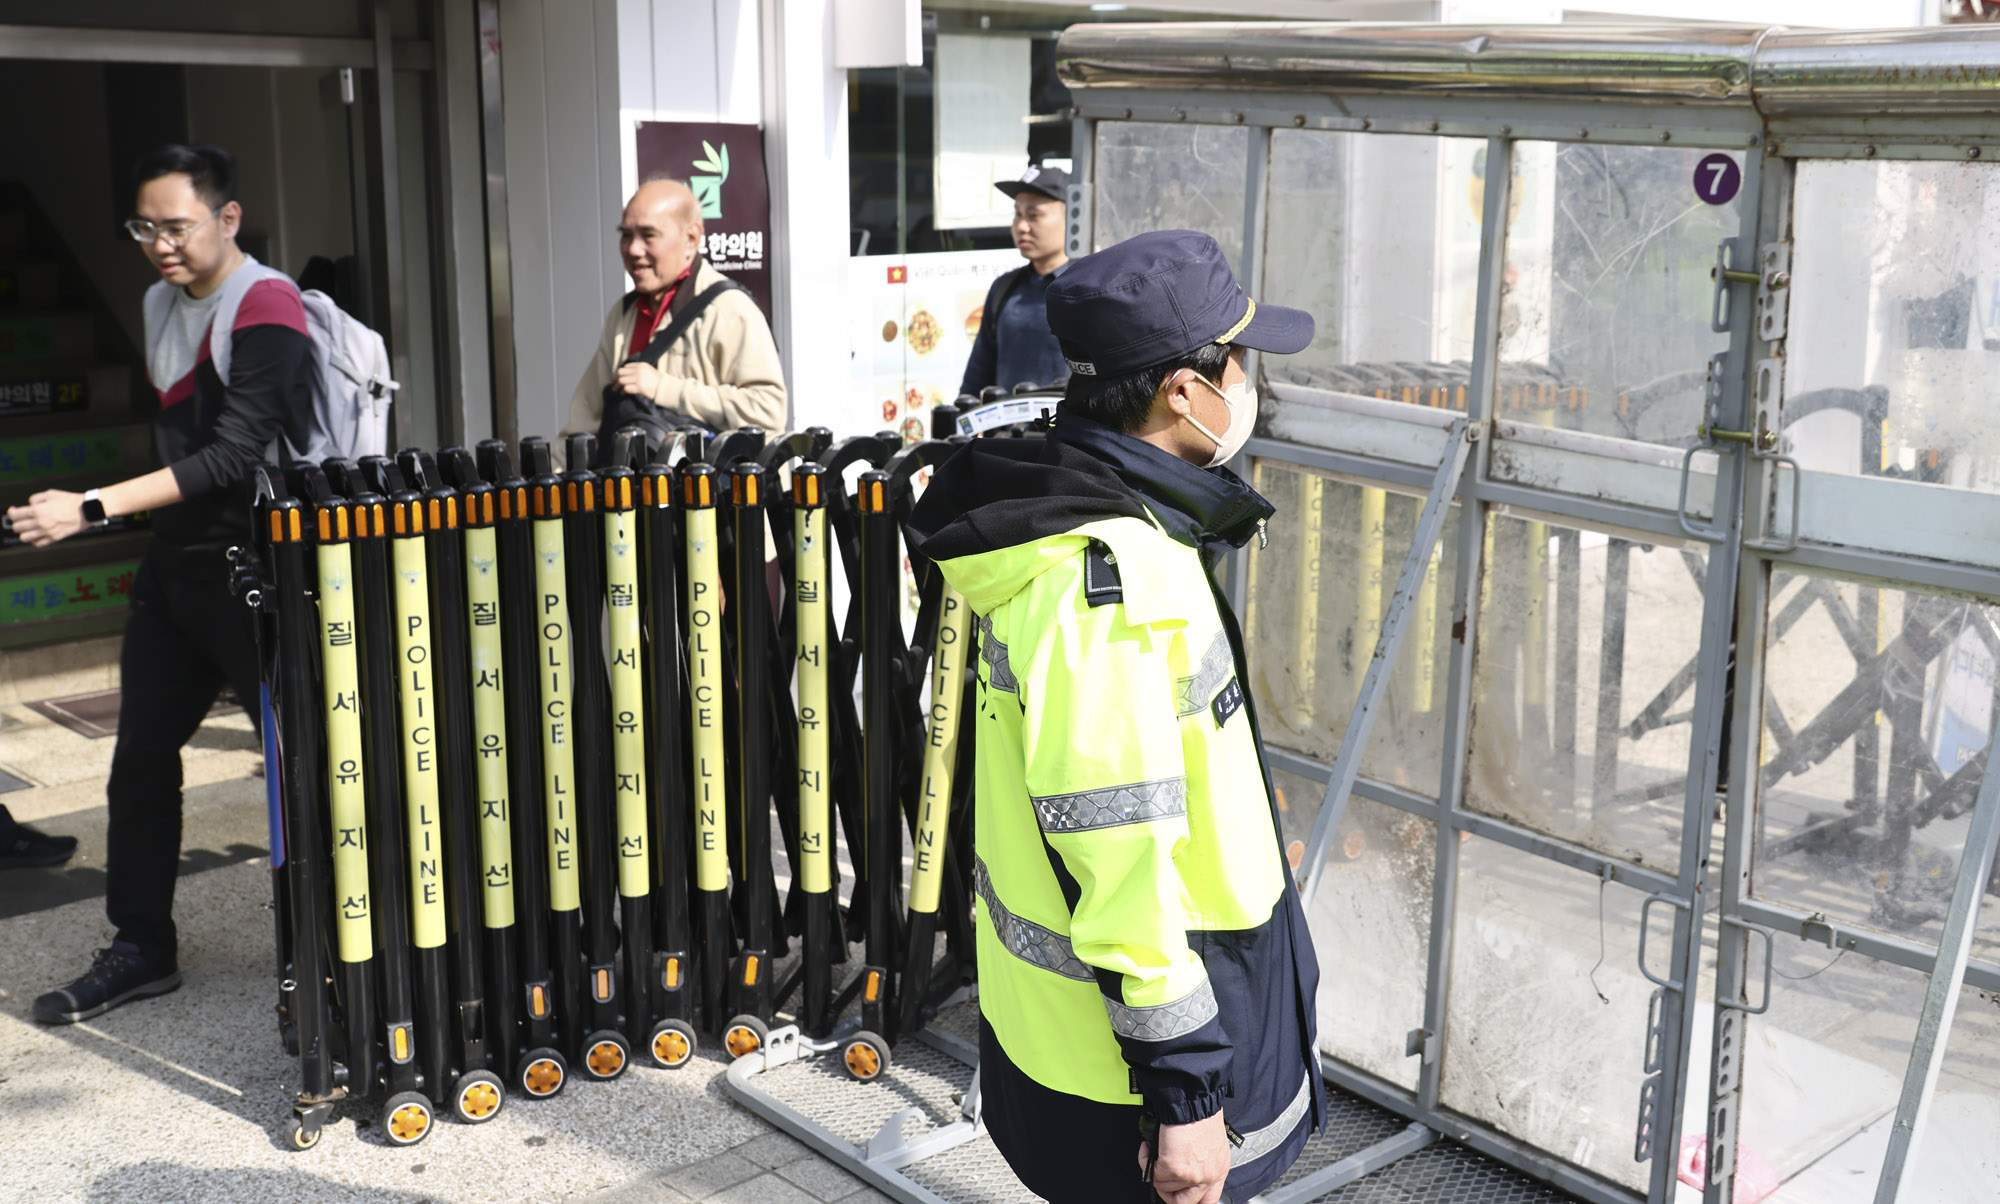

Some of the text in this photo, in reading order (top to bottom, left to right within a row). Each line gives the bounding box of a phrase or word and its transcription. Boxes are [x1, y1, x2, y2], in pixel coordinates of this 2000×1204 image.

[1706, 163, 1728, 196] 7
[327, 620, 368, 920] 질서유지선
[407, 616, 439, 905] POLICE LINE
[472, 602, 510, 888] 질서유지선
[543, 594, 571, 870] POLICE LINE
[610, 583, 643, 859] 질서유지선
[692, 582, 716, 851] POLICE LINE
[797, 580, 821, 854] 질서유지선
[916, 598, 958, 873] POLICE LINE
